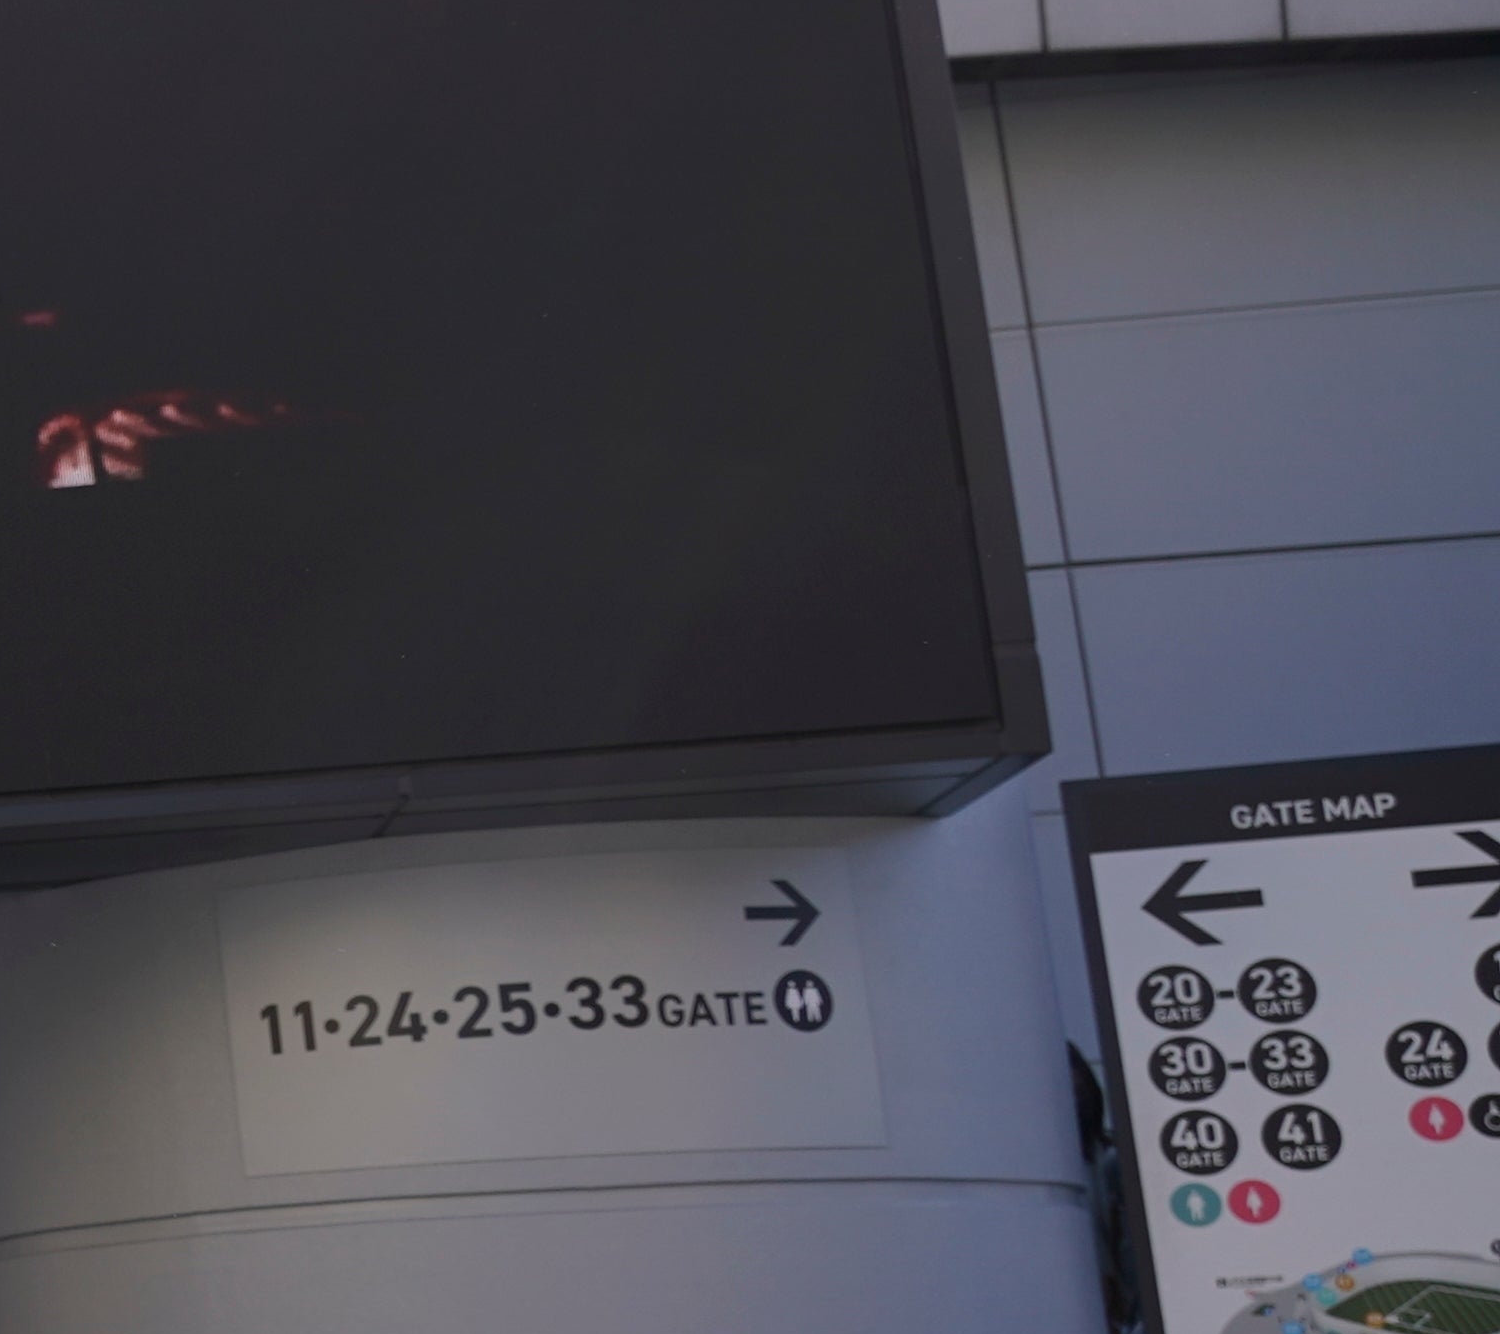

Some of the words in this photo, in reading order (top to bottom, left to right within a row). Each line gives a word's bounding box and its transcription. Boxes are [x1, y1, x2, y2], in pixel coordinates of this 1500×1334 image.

[1230, 799, 1316, 830] GATE
[1322, 793, 1396, 821] MAP
[1148, 973, 1200, 1007] 20
[1249, 967, 1303, 1000] 23
[1154, 1007, 1203, 1023] GATE
[1255, 1000, 1304, 1017] GATE
[1158, 1043, 1213, 1077] 30
[1261, 1037, 1315, 1070] 33
[1398, 1029, 1454, 1063] 24
[1165, 1078, 1214, 1095] GATE
[1267, 1071, 1317, 1088] GATE
[1404, 1064, 1454, 1081] GATE
[1170, 1116, 1225, 1150] 40
[1277, 1111, 1325, 1144] 41
[1176, 1150, 1226, 1168] GATE
[1279, 1145, 1329, 1163] GATE
